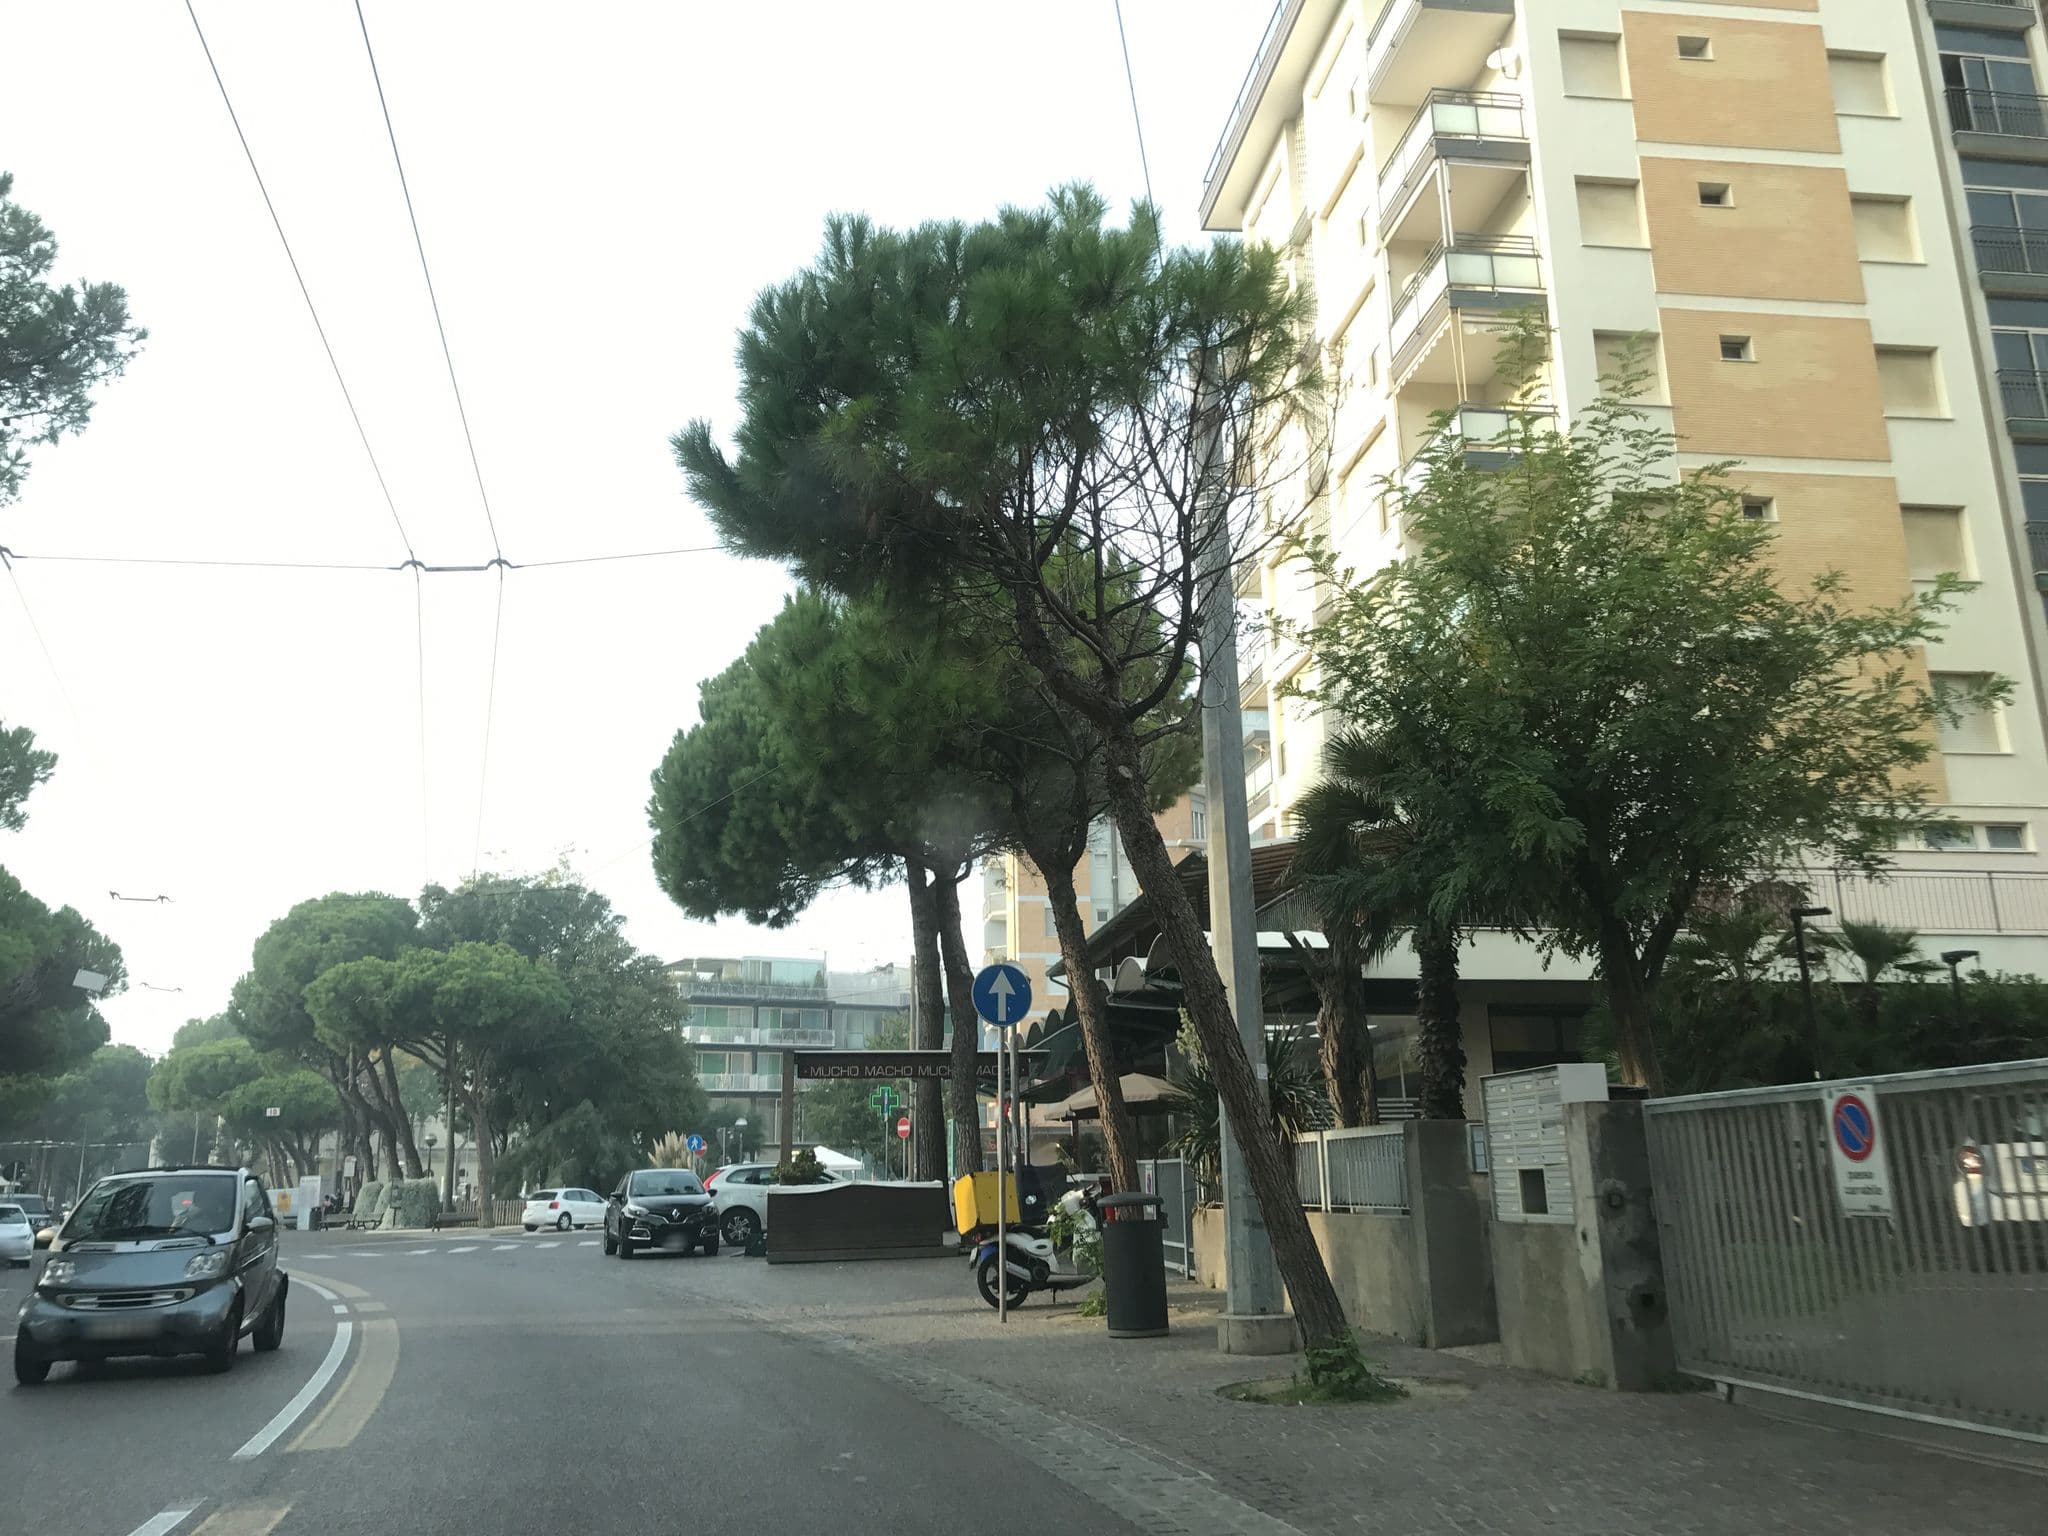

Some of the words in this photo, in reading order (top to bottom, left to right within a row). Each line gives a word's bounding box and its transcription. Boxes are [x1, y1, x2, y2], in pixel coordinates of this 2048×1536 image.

[810, 1065, 860, 1077] MUCHO
[864, 1065, 913, 1077] MACHO
[918, 1065, 954, 1076] MUCH
